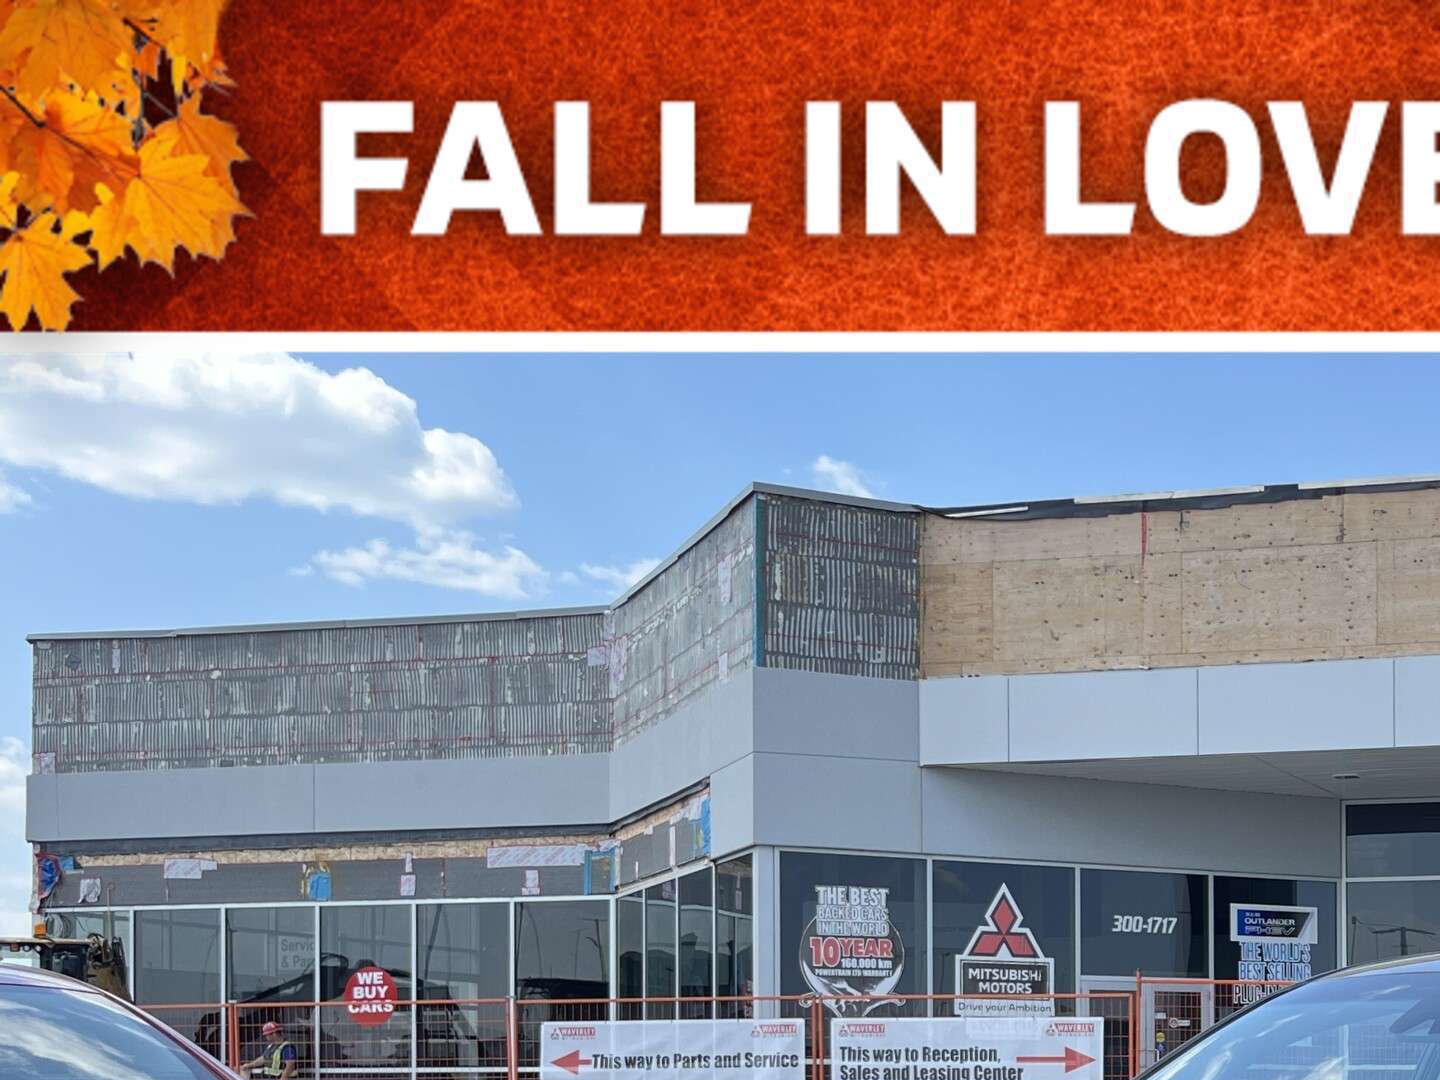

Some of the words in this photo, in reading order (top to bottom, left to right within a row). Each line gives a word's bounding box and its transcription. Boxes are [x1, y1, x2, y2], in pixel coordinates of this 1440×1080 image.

[815, 886, 847, 905] THE
[849, 886, 889, 906] BEST
[818, 905, 860, 919] BACKED
[861, 906, 889, 920] CARS
[850, 921, 889, 935] WORLD
[1112, 915, 1178, 934] 300-1717
[1244, 917, 1296, 926] OUTLANDER
[809, 937, 841, 968] 10
[839, 938, 893, 958] YEAR
[1241, 942, 1261, 961] THE
[1262, 942, 1311, 963] WORLD'S
[357, 972, 384, 985] WE
[968, 968, 1041, 981] MITSUBISHI
[1239, 962, 1266, 980] BEST
[1267, 962, 1312, 981] SELLING
[353, 986, 388, 999] BUY
[979, 982, 1032, 994] MOTORS
[348, 1000, 394, 1014] CARS
[958, 1002, 983, 1012] Drive
[985, 1004, 1006, 1013] your
[1008, 1003, 1051, 1013] Ambition
[1057, 1023, 1094, 1032] WAVERLEY
[592, 1053, 622, 1069] This
[624, 1056, 653, 1070] way
[656, 1054, 670, 1069] to
[673, 1053, 711, 1069] Parts
[714, 1052, 741, 1068] and
[744, 1052, 799, 1068] Service
[840, 1046, 870, 1062] This
[872, 1048, 902, 1064] way
[905, 1047, 919, 1062] to
[922, 1046, 1001, 1064] Reception,
[840, 1065, 880, 1080] Sales
[883, 1065, 910, 1080] and
[974, 1065, 1024, 1080] Center
